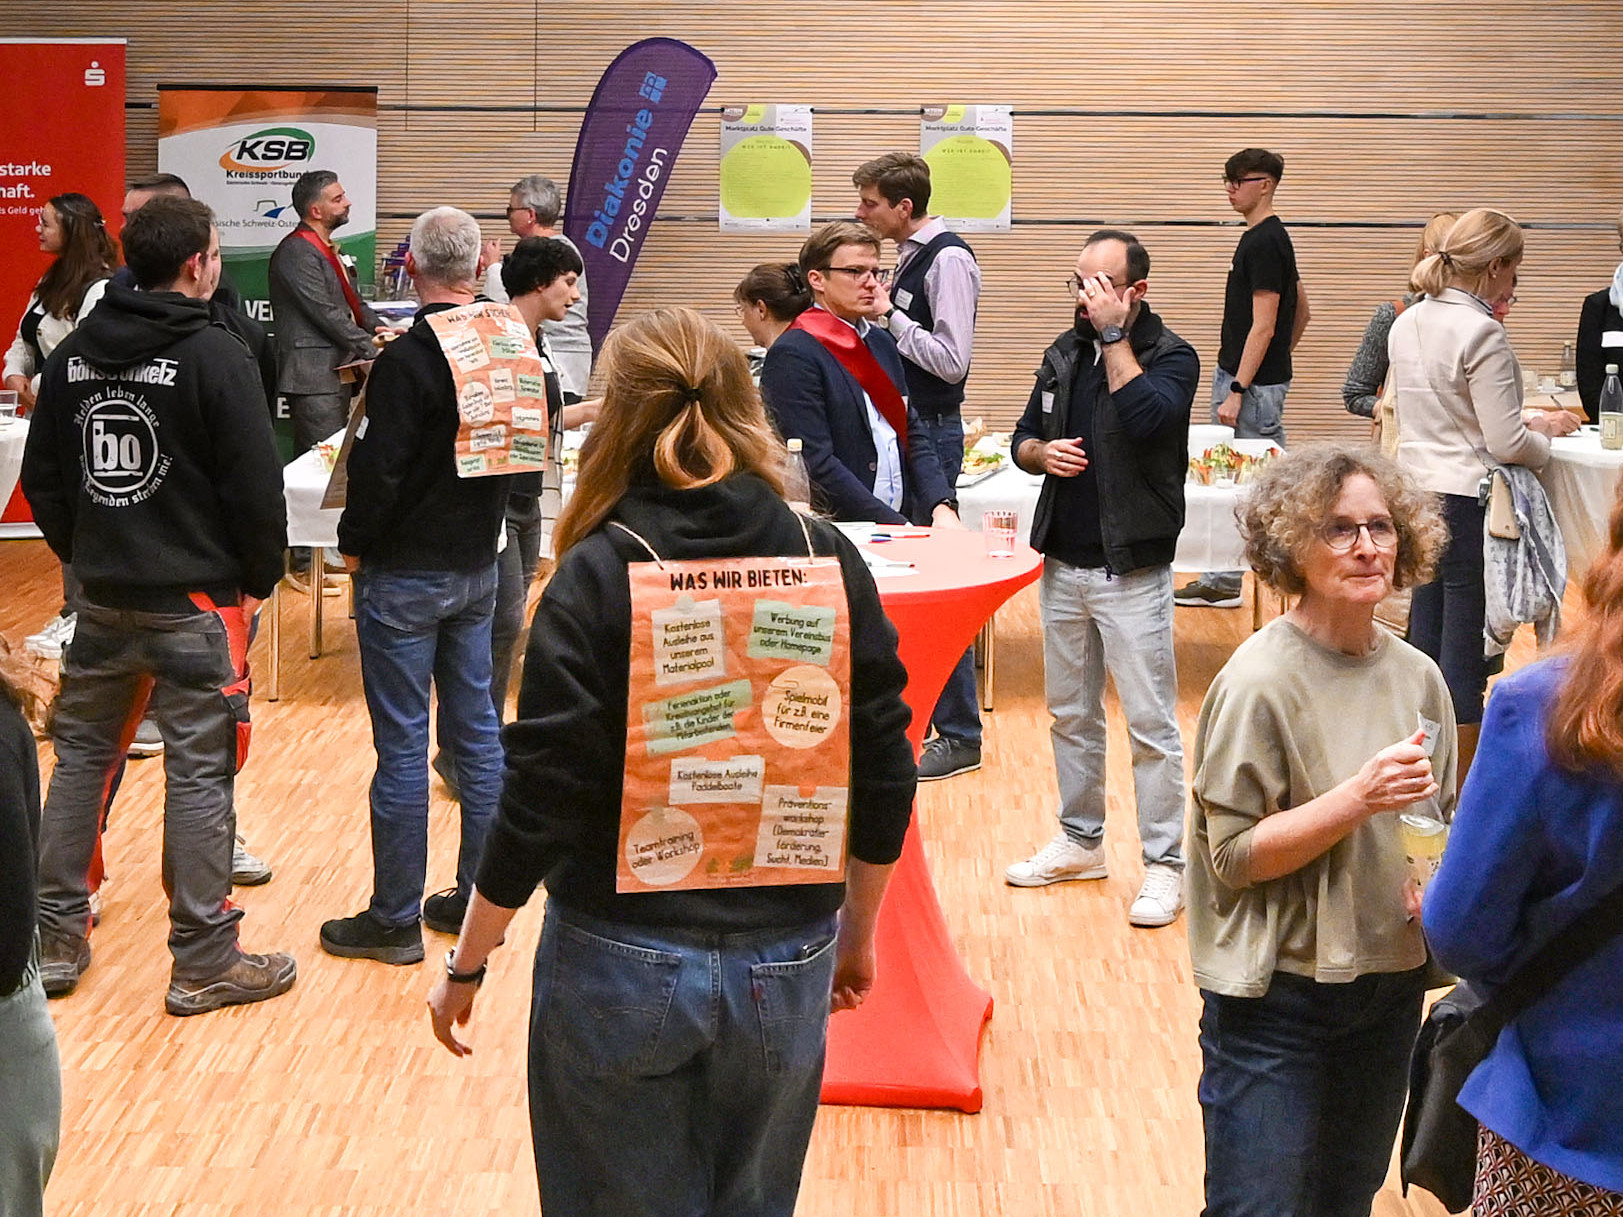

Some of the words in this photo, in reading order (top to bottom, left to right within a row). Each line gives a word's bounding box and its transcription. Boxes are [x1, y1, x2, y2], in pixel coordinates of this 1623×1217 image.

[236, 140, 310, 160] KSB
[585, 109, 653, 248] Diakonie
[8, 206, 28, 215] Geld
[609, 148, 667, 263] Dresden
[92, 418, 142, 471] bo
[670, 572, 707, 591] WAS
[713, 571, 742, 589] WIR
[748, 569, 808, 588] BIETEN:
[664, 619, 711, 634] Kostenlose
[771, 613, 804, 628] Werbung
[806, 618, 821, 628] auf
[663, 632, 698, 648] Ausleihe
[700, 632, 714, 641] aus
[754, 626, 788, 636] unserem
[791, 628, 831, 642] Vereinsbus
[670, 647, 708, 660] unserem
[760, 638, 778, 648] oder
[781, 639, 821, 655] Homepage
[663, 657, 714, 674] Materialpool
[714, 690, 731, 700] oder
[784, 690, 828, 706] Spielmobil
[697, 713, 719, 725] Kinder
[777, 703, 791, 714] für
[811, 710, 830, 720] eine
[774, 716, 827, 733] Firmenfeier
[677, 770, 723, 780] Kostenlose
[725, 768, 758, 779] Ausleihe
[692, 781, 744, 791] Paddelboote
[783, 813, 824, 825] workshop
[633, 831, 694, 854] Teamtraining
[632, 857, 653, 869] oder
[656, 843, 700, 861] Workshop
